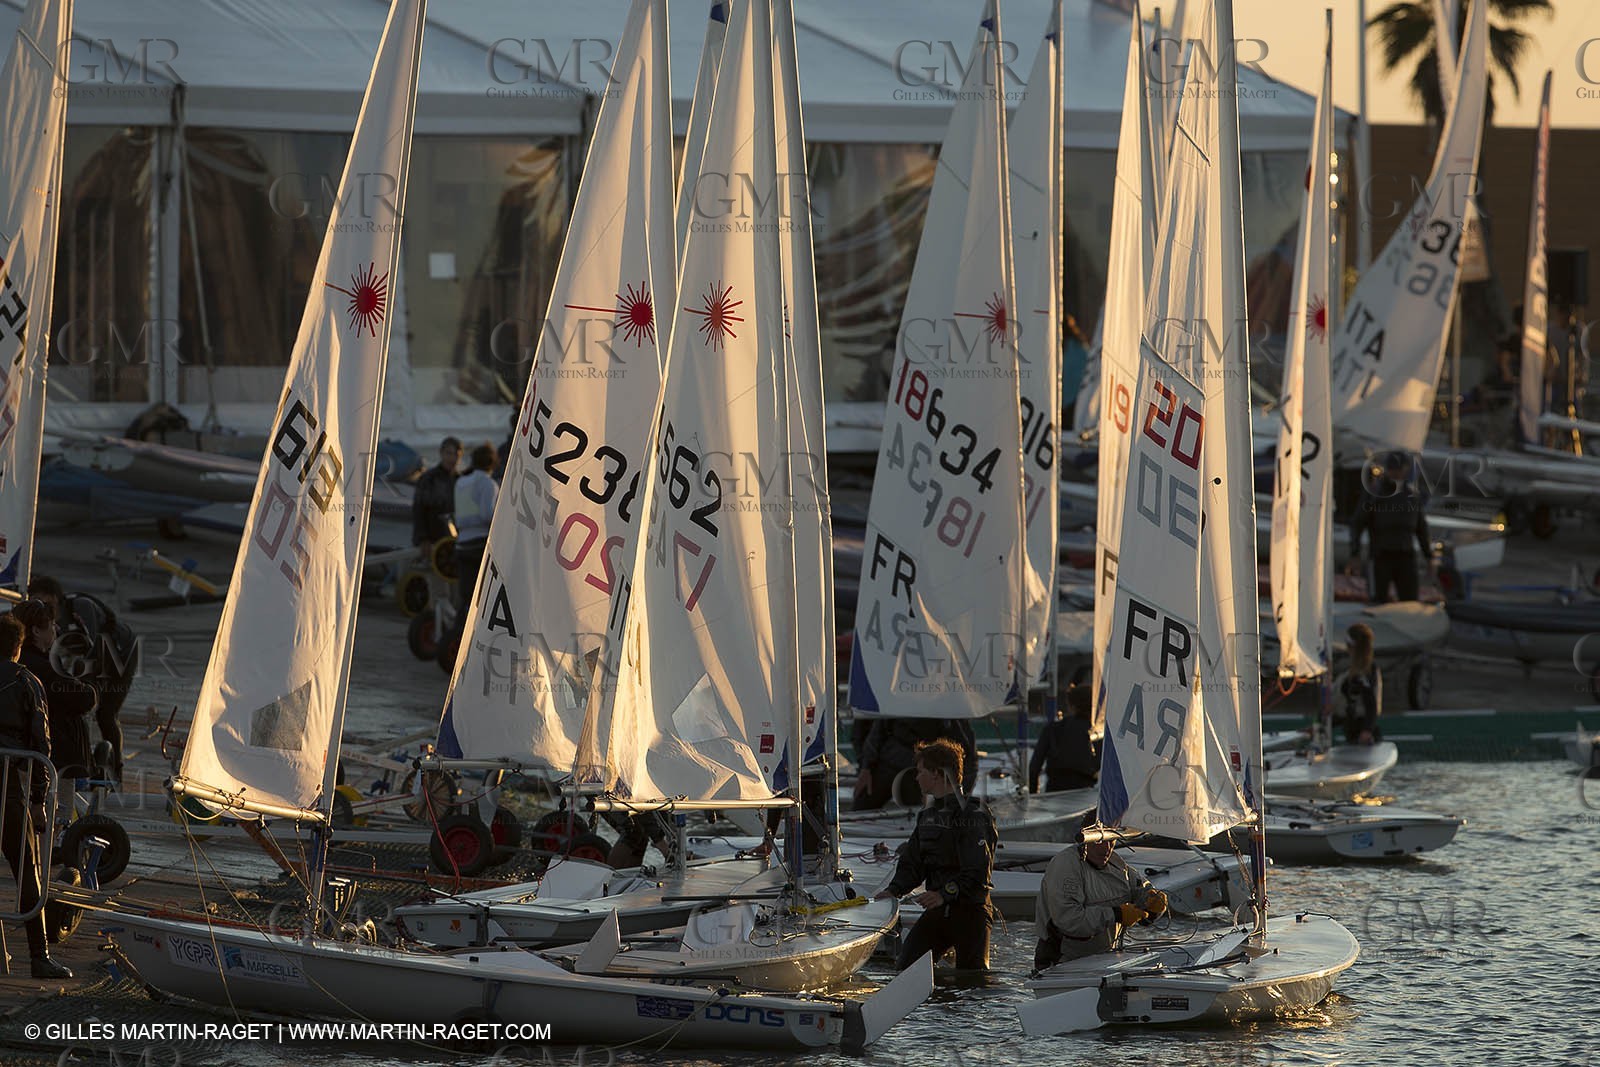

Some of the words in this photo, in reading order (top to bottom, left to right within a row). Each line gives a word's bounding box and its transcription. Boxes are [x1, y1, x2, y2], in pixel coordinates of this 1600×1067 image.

[1346, 302, 1386, 362] ITA
[1108, 374, 1131, 434] 19
[1143, 380, 1204, 470] 20
[270, 386, 342, 515] 613
[247, 959, 299, 978] MARSEILLE
